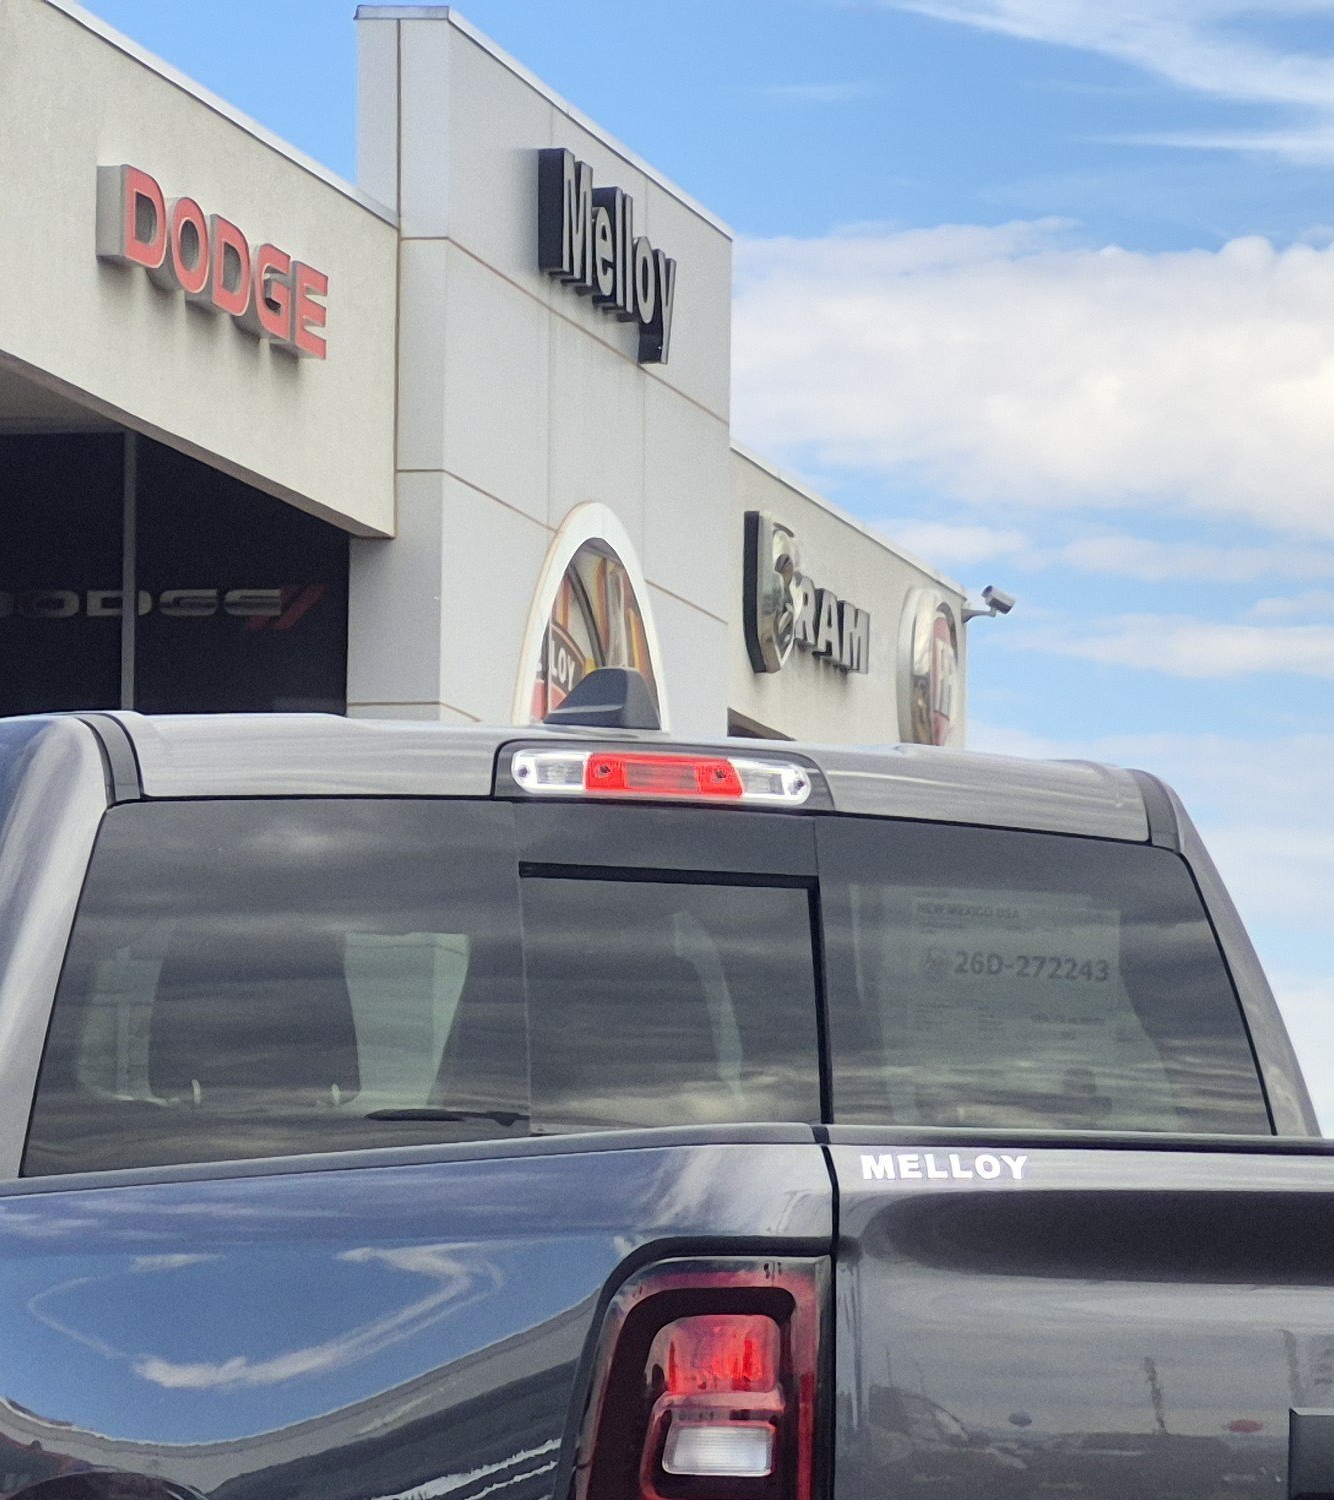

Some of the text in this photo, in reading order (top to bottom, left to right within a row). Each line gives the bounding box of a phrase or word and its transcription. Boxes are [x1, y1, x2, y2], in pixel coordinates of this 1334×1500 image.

[96, 164, 328, 360] DODGE
[538, 148, 676, 364] Melloy
[794, 571, 870, 675] RAM
[953, 949, 1110, 983] 26D-272243
[859, 1154, 1028, 1181] MELLOY
